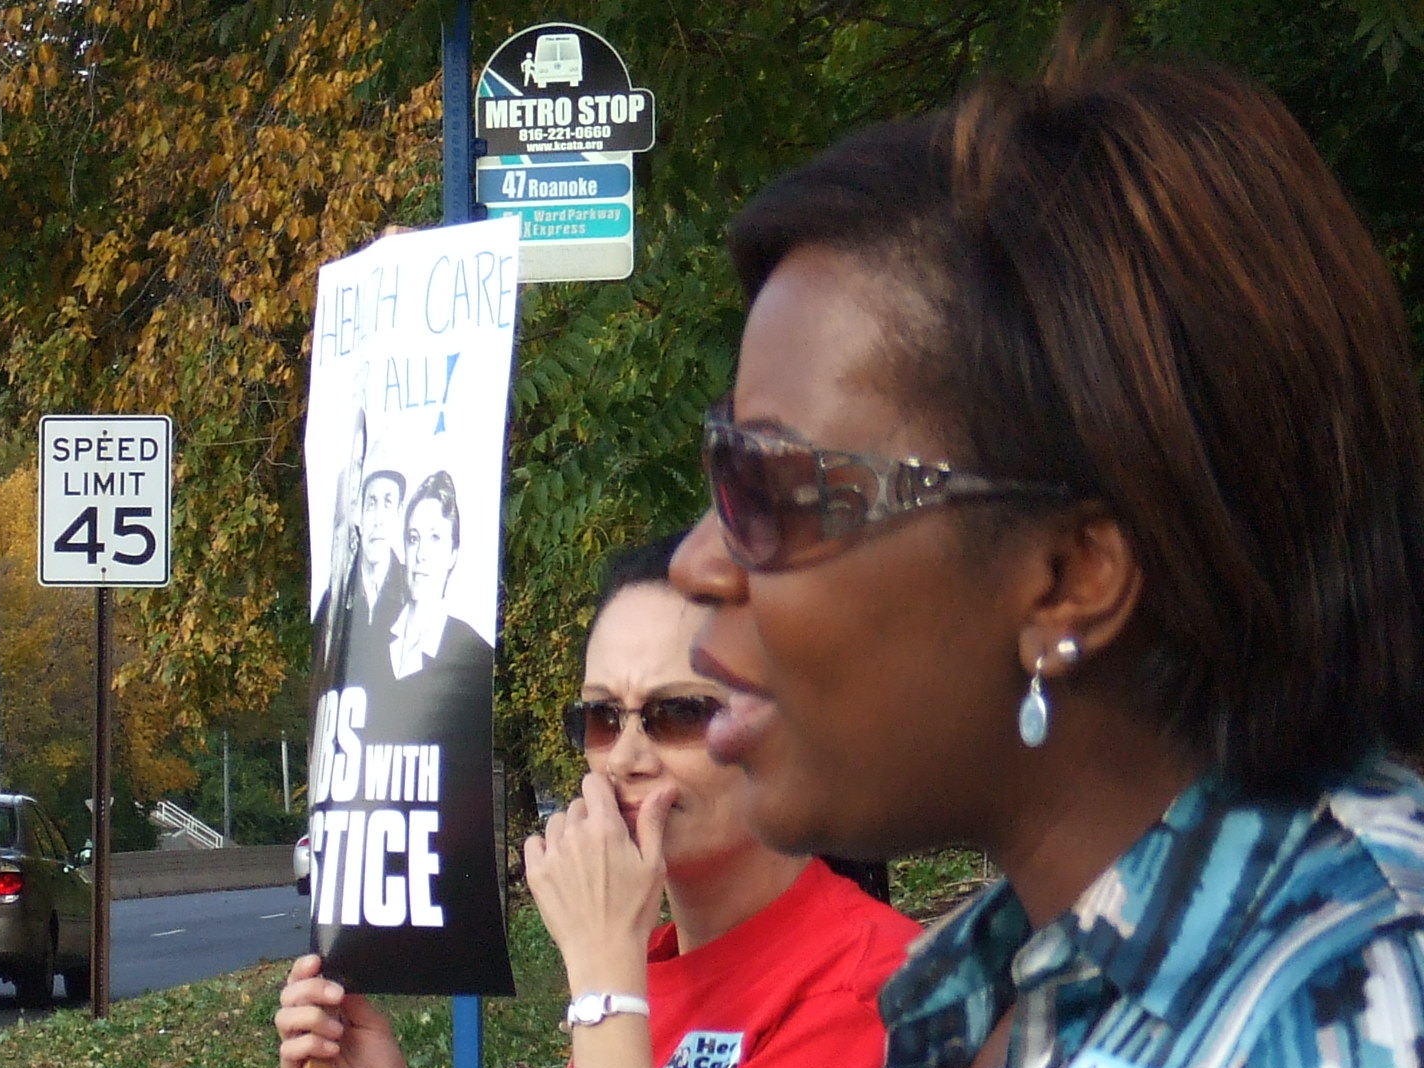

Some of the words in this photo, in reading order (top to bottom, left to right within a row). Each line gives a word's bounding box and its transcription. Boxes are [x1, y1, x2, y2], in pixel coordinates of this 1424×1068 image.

[485, 97, 572, 128] METRO
[578, 94, 645, 126] STOP
[519, 126, 611, 142] 816-221-0660
[526, 140, 604, 152] www.kcata.org
[502, 171, 526, 199] 47
[528, 177, 598, 198] Roanoke
[534, 209, 566, 222] Ward
[533, 223, 586, 236] Express
[319, 264, 399, 367] HEAH
[425, 251, 514, 334] CARE
[384, 352, 461, 436] ALL!
[52, 437, 159, 462] SPEED
[64, 472, 146, 496] LIMIT
[54, 506, 157, 566] 45
[365, 744, 441, 802] WITH
